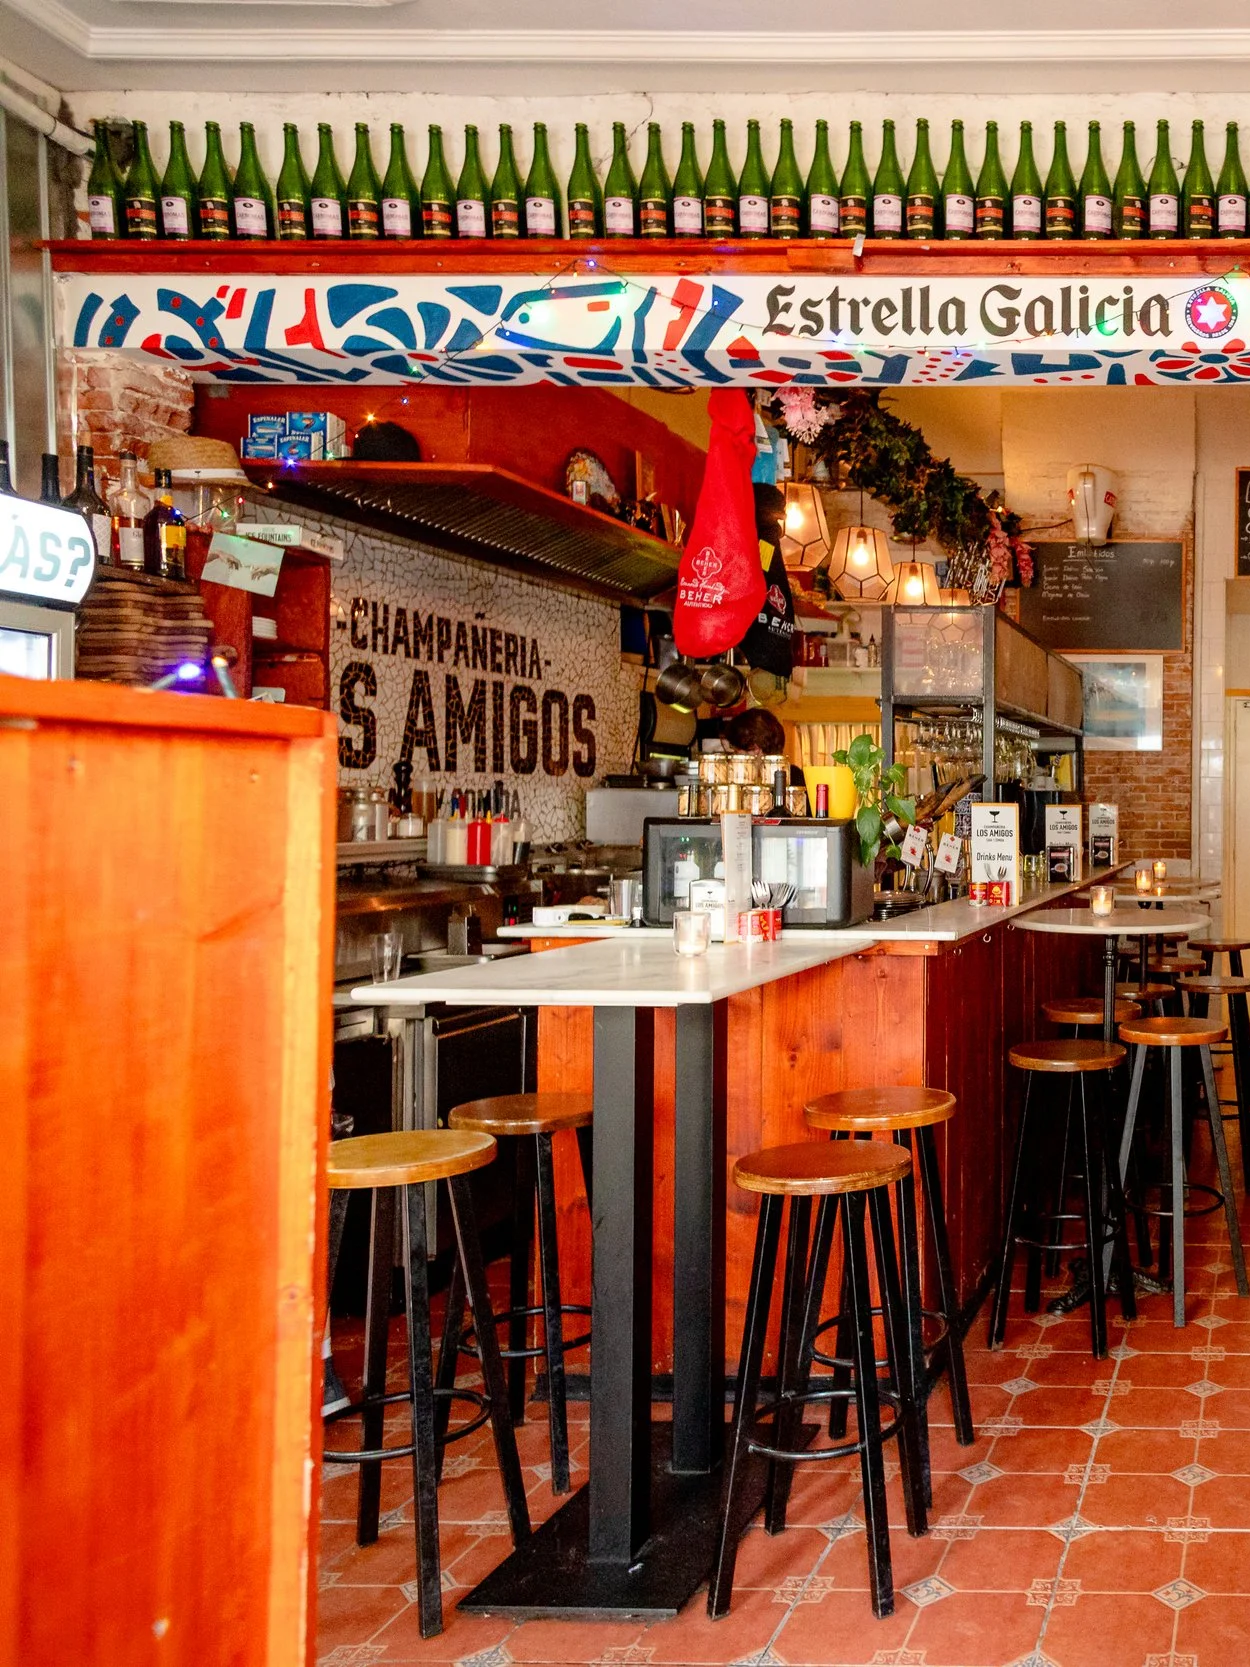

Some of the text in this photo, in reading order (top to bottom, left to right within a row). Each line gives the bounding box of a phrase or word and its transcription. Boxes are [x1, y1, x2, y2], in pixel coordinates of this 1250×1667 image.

[761, 284, 968, 337] Estrella
[979, 284, 1174, 337] Galicia
[680, 589, 723, 605] BEHER
[400, 669, 596, 778] AMIGOS
[977, 829, 1013, 837] LOS AMIGOS
[977, 852, 1013, 861] Drinks Menu
